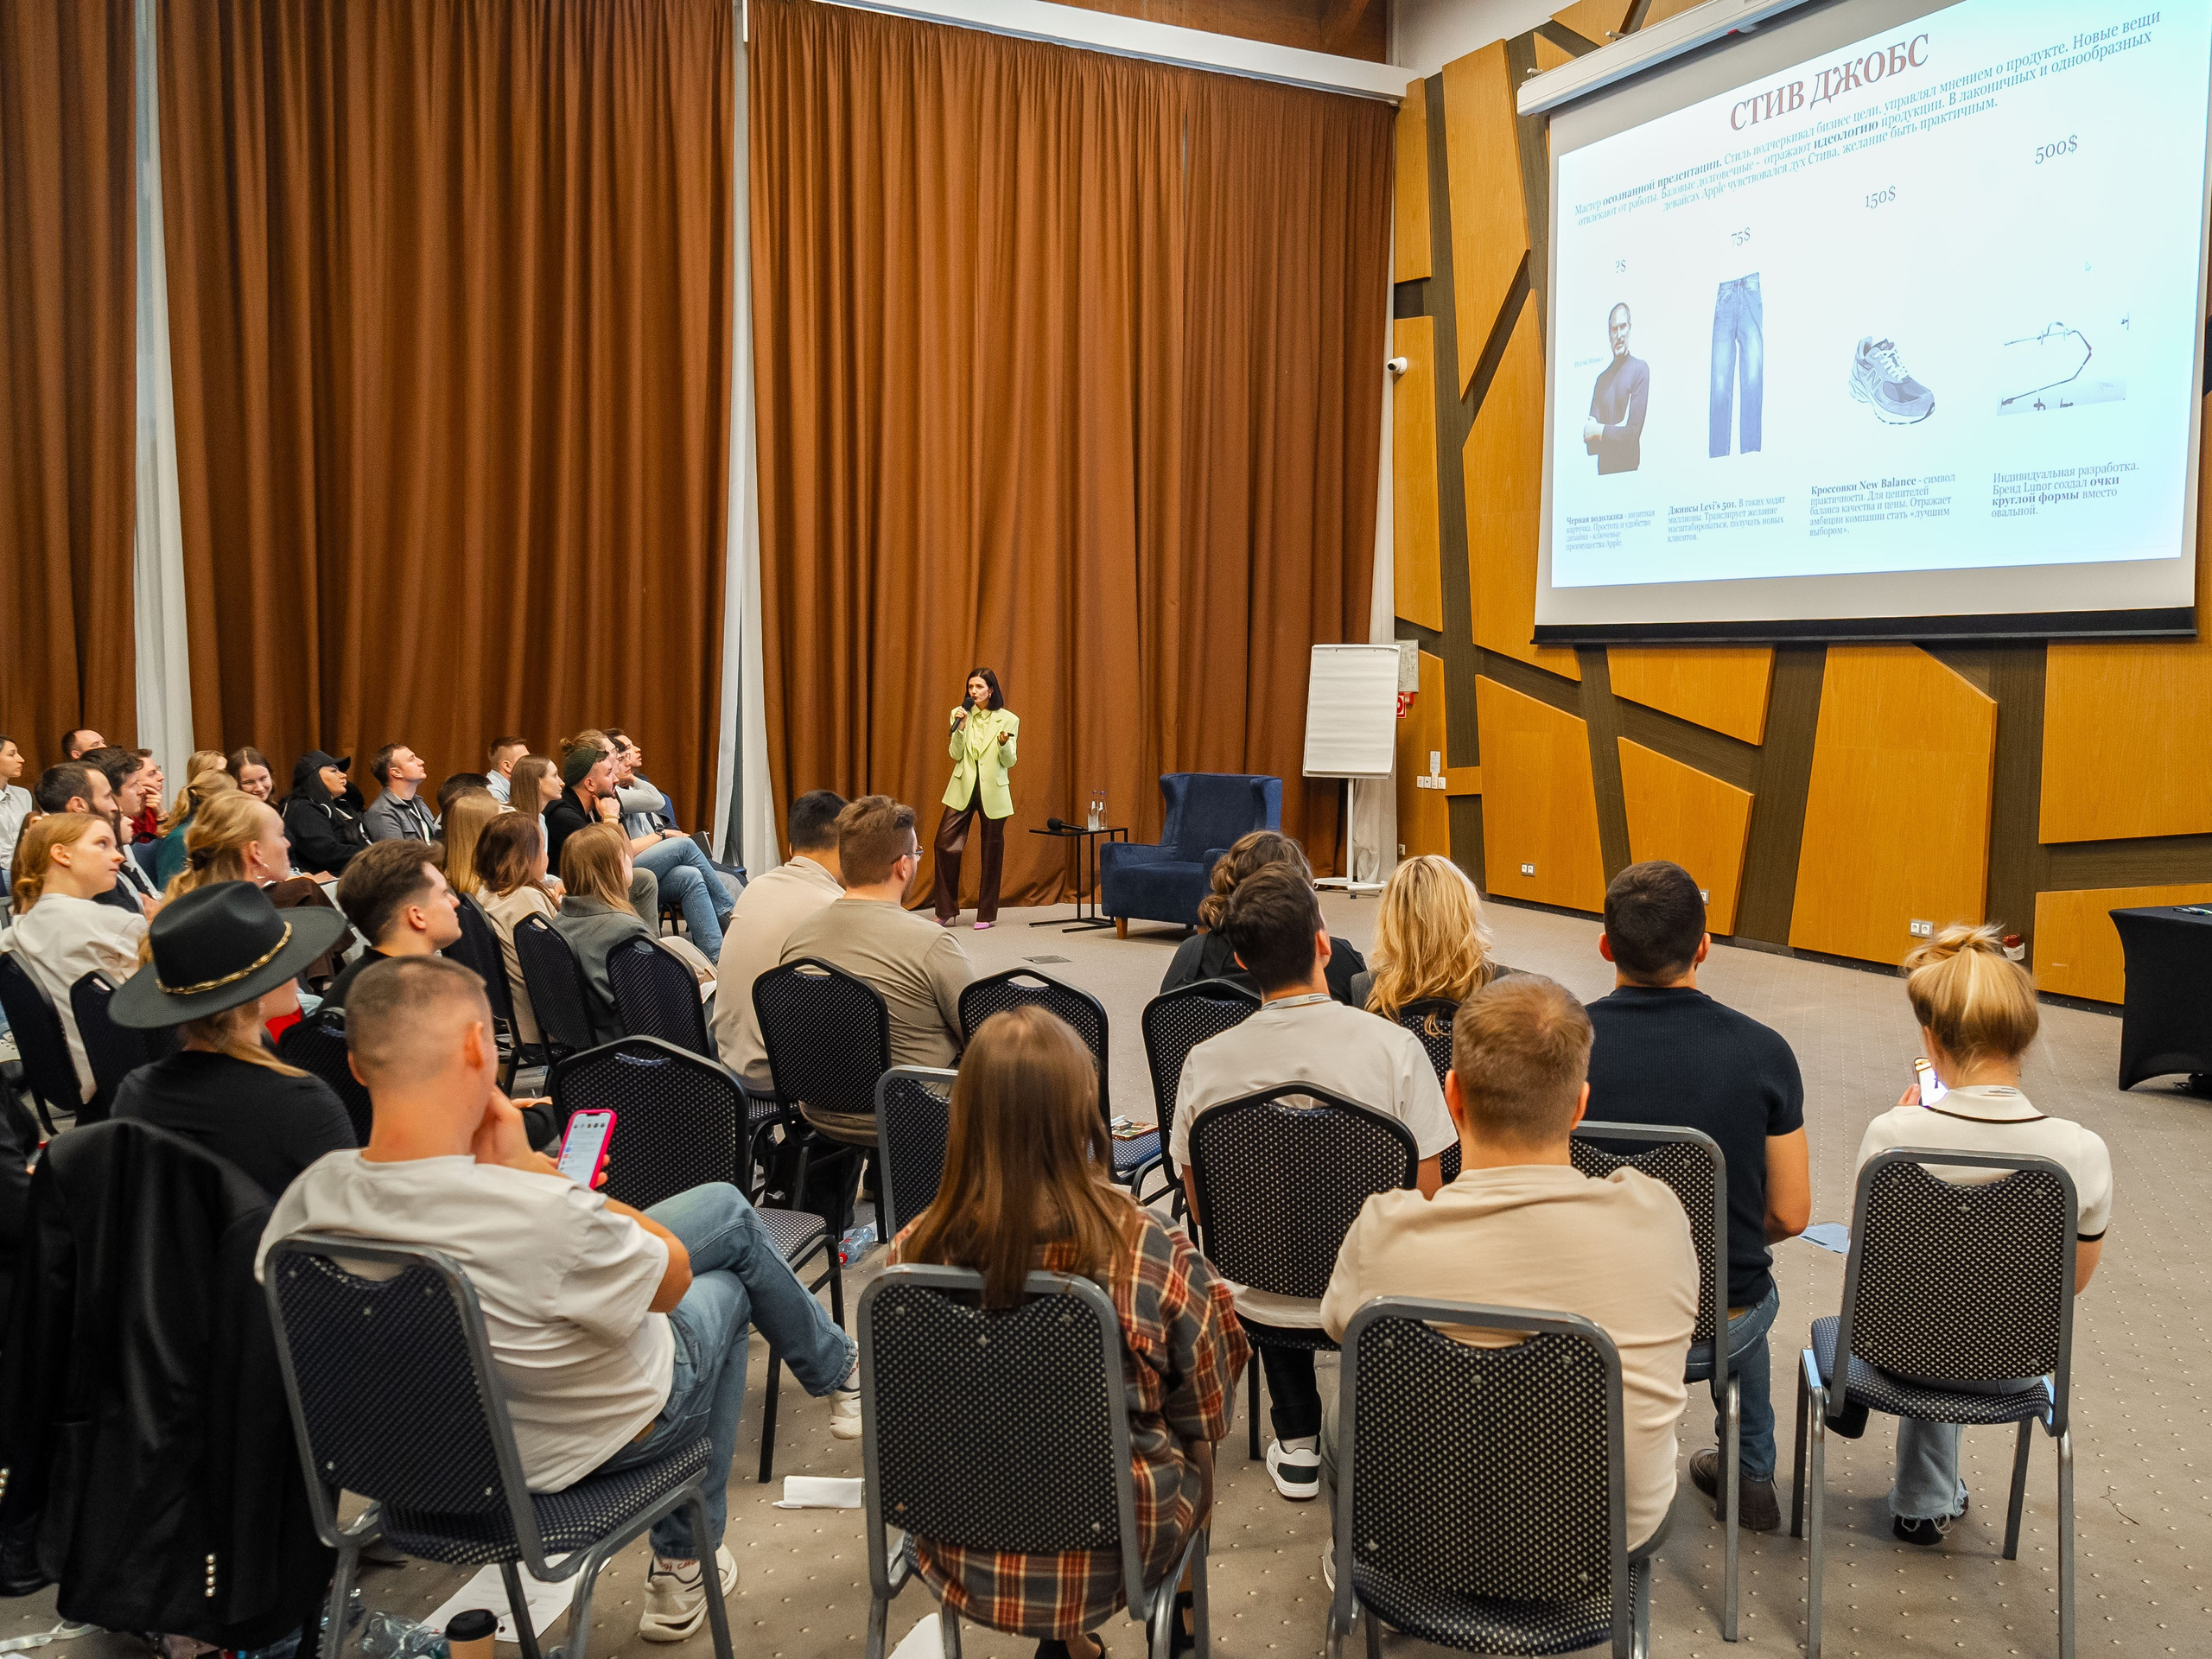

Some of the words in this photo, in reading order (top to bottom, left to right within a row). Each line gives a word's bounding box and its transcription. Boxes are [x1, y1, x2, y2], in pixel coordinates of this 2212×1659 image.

[1730, 80, 1805, 131] СТИВ
[1810, 33, 1929, 111] ДЖОБС
[1574, 200, 1602, 216] Мастер
[1603, 179, 1656, 206] осознанной
[1657, 159, 1722, 188] презентации.
[1724, 149, 1751, 165] Стиль
[1753, 127, 1815, 156] подчеркивал
[1816, 115, 1851, 134] бизнес
[1884, 86, 1936, 116] управлял
[1940, 67, 1993, 94] мнением
[1996, 64, 2004, 74] о
[2006, 42, 2069, 73] продукте.
[2073, 25, 2119, 50] Новые
[2122, 11, 2160, 34] вещи
[1578, 207, 1618, 226] отвлекают
[1618, 203, 1627, 213] от
[1628, 194, 1659, 213] работы.
[1661, 181, 1696, 200] Базовые
[1697, 159, 1754, 189] долговечные
[1764, 142, 1812, 167] отражают
[1815, 119, 1878, 149] идеологию
[1882, 99, 1945, 129] продукции.
[1948, 92, 1956, 105] В
[1959, 69, 2036, 102] лаконичных
[2039, 65, 2048, 77] и
[2051, 31, 2152, 73] однообразных
[1663, 193, 1700, 213] девайсах
[1701, 181, 1726, 200] Apple
[1728, 164, 1787, 193] чувствовался
[1789, 157, 1806, 173] дух
[1842, 131, 1887, 155] желание
[1891, 123, 1917, 140] быть
[1920, 98, 1998, 131] практичным.
[2034, 134, 2078, 165] 500$
[1865, 185, 1897, 209] 150$
[1732, 226, 1751, 248] 75$
[1993, 468, 2075, 484] Индивидуальная
[2077, 462, 2139, 479] разработка.
[1811, 484, 1858, 497] Кроссовки
[1859, 480, 1879, 491] New
[1881, 477, 1916, 488] Balance
[1923, 474, 1955, 485] символ
[1993, 485, 2021, 497] Бренд
[2024, 482, 2052, 493] Lunor
[2054, 479, 2088, 491] создал
[2089, 477, 2120, 487] очки
[1668, 506, 1699, 515] Джинсы
[1721, 501, 1737, 511] 501.
[1738, 499, 1744, 507] В
[1745, 498, 1764, 507] таких
[1765, 496, 1785, 505] ходят
[1809, 506, 1840, 516] баланса
[1841, 503, 1875, 513] качества
[1885, 499, 1908, 510] цены.
[1910, 496, 1951, 508] Отражает
[1811, 493, 1866, 506] практичности.
[1867, 491, 1884, 501] Для
[1885, 486, 1929, 499] ценителей
[1993, 493, 2036, 508] круглой
[2038, 491, 2079, 505] формы
[2082, 488, 2118, 499] вместо
[1567, 517, 1590, 525] Черная
[1590, 513, 1623, 524] водолазка
[1668, 515, 1702, 524] миллионы.
[1705, 511, 1746, 522] Транслирует
[1747, 506, 1778, 517] желание
[1809, 516, 1844, 527] амбиции
[1845, 513, 1885, 524] компании
[1886, 512, 1908, 520] стать
[1910, 508, 1950, 519] «лучшим
[1991, 505, 2038, 518] овальной.
[1668, 521, 1729, 532] масштабироваться,
[1730, 518, 1761, 529] получать
[1763, 517, 1784, 525] новых
[1809, 525, 1849, 537] выбором».
[1668, 533, 1699, 543] клиентов.
